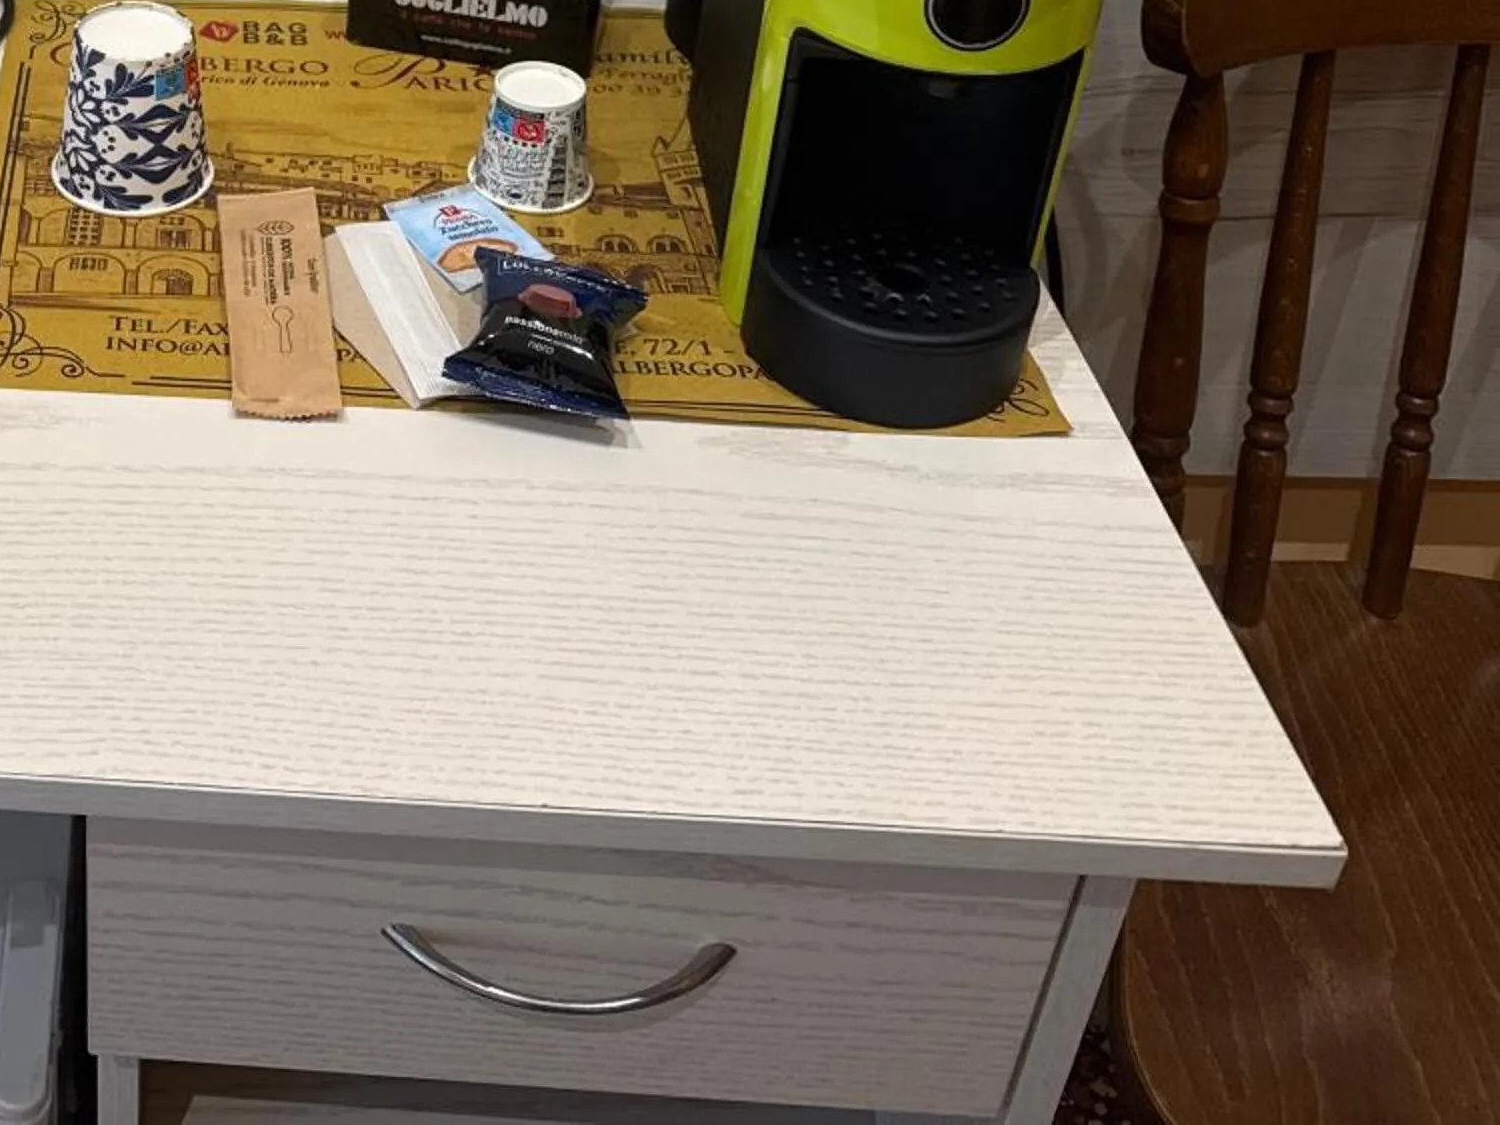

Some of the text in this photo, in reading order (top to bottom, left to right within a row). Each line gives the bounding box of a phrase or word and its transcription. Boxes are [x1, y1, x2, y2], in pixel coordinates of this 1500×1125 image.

[242, 20, 307, 34] BAG
[243, 33, 308, 46] B&B
[200, 55, 329, 75] BERGO
[201, 75, 237, 85] rico
[642, 337, 714, 356] 72/1
